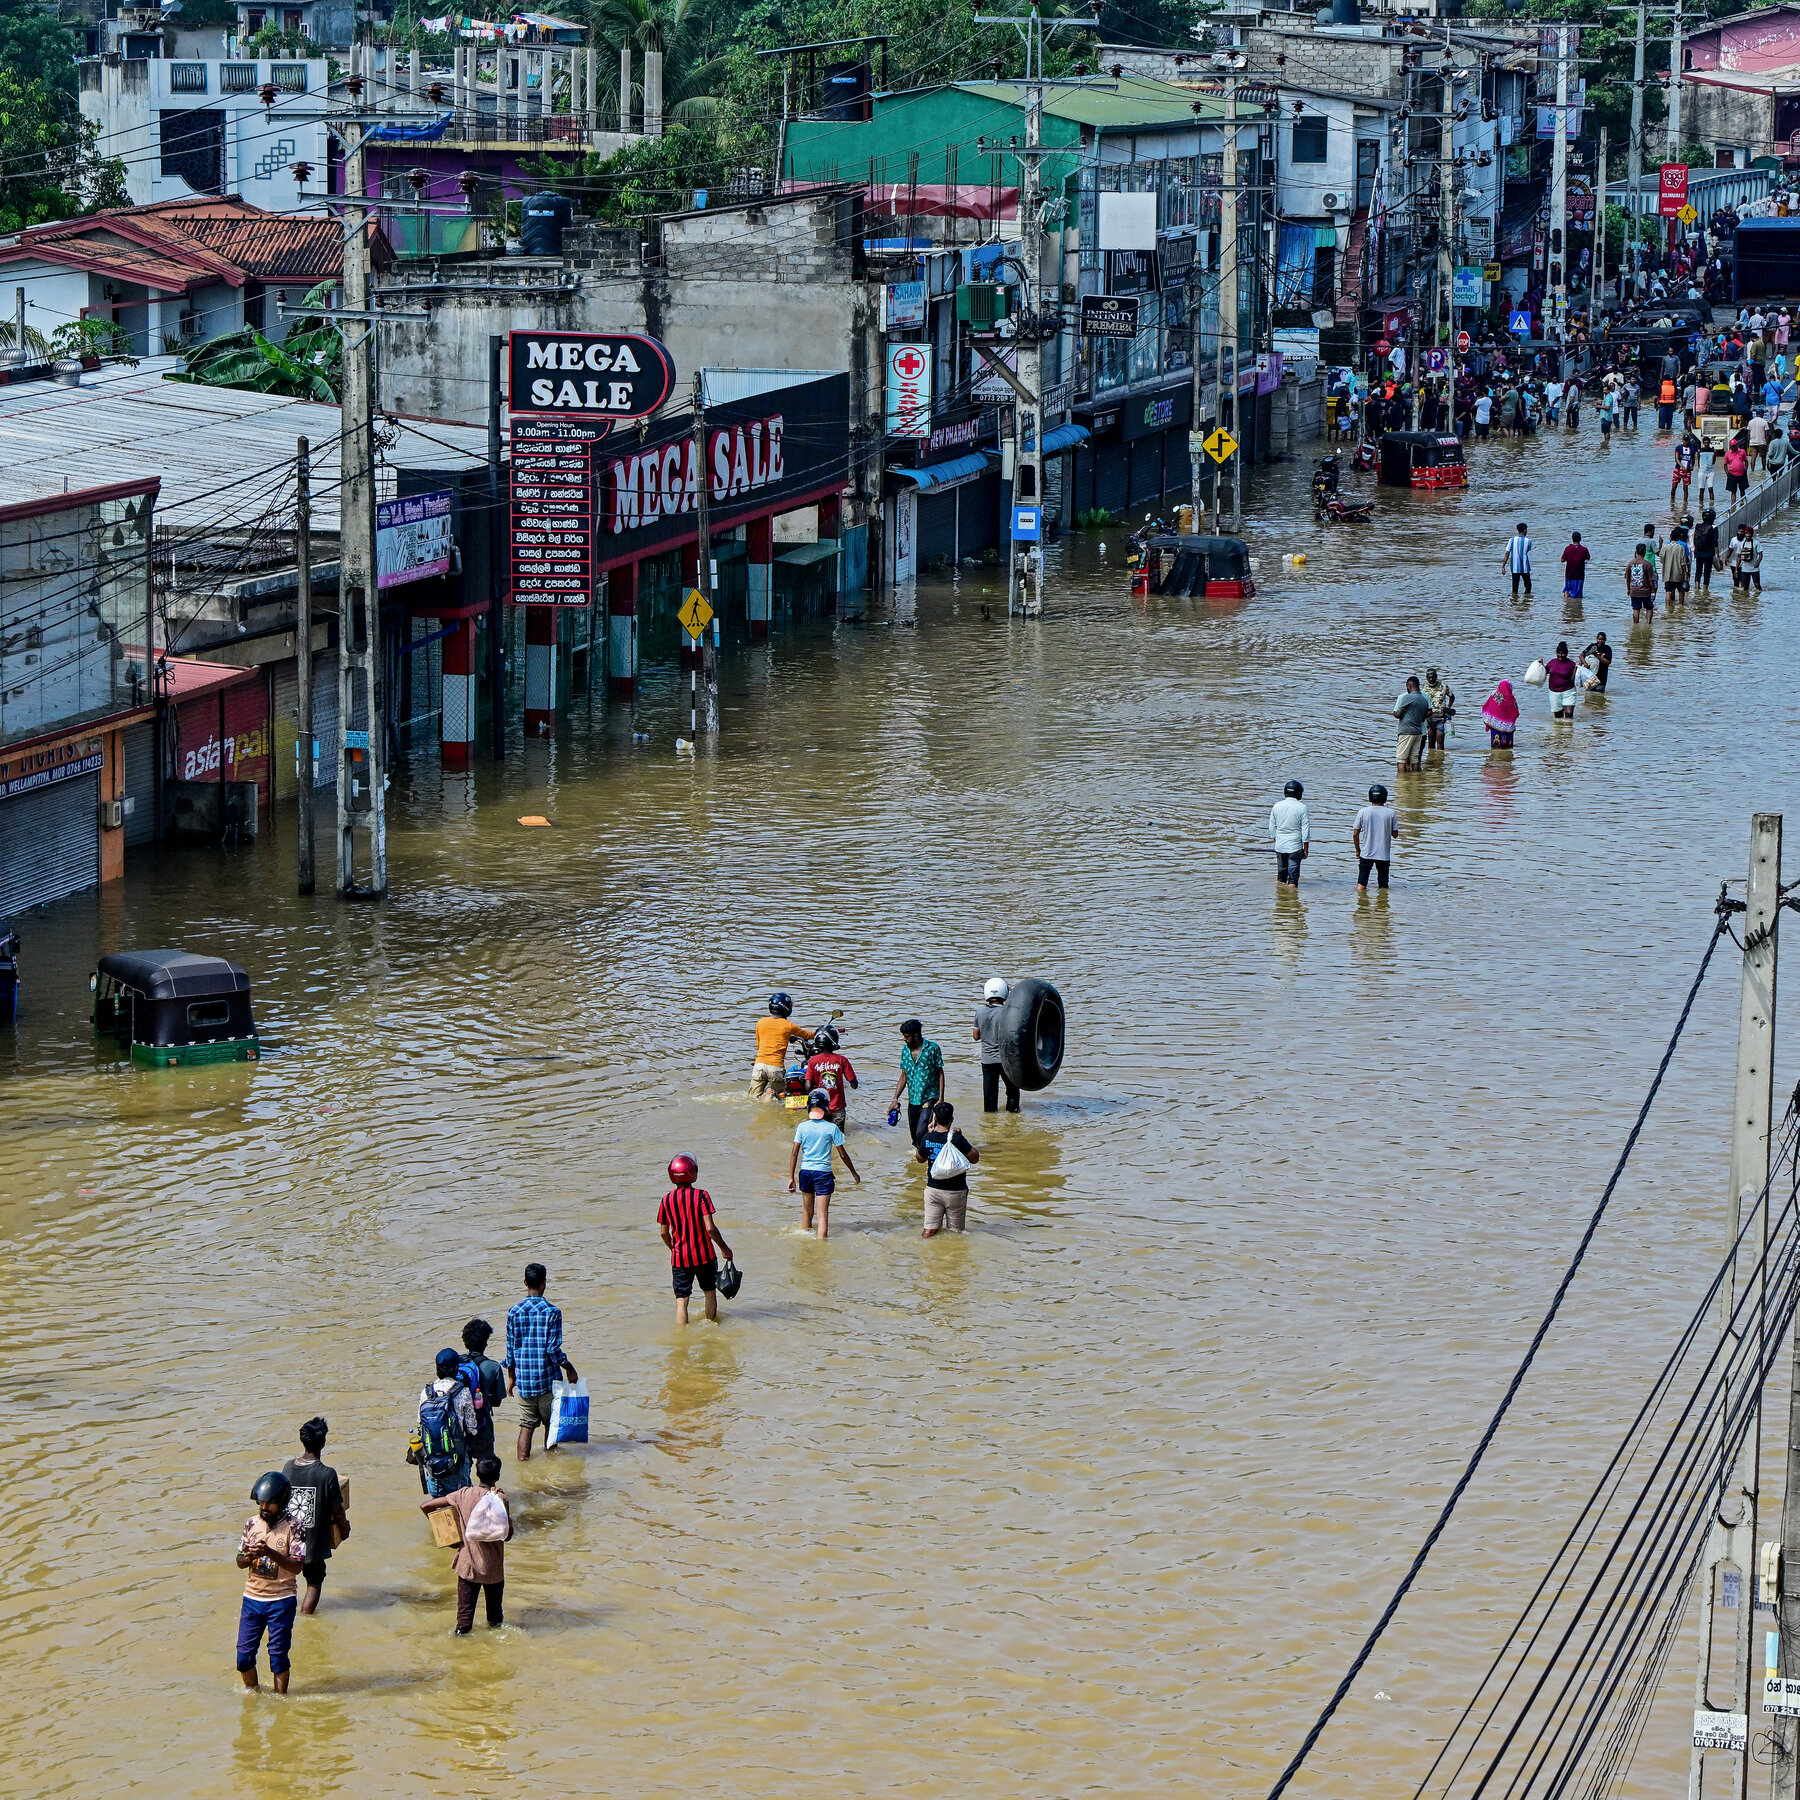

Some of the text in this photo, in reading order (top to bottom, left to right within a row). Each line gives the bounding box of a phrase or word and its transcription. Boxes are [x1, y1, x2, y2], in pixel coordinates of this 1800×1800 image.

[1566, 195, 1594, 209] SPORTS
[1086, 310, 1133, 321] INFINITY
[1086, 320, 1133, 332] PREMIER
[527, 342, 641, 373] MEGA
[531, 378, 633, 410] SALE
[517, 428, 550, 437] 9.00am
[558, 428, 596, 439] 11.00pm
[945, 417, 980, 446] PHARMACY
[611, 415, 784, 534] MEGA SALE
[1695, 1738, 1745, 1750] 0760 377 543
